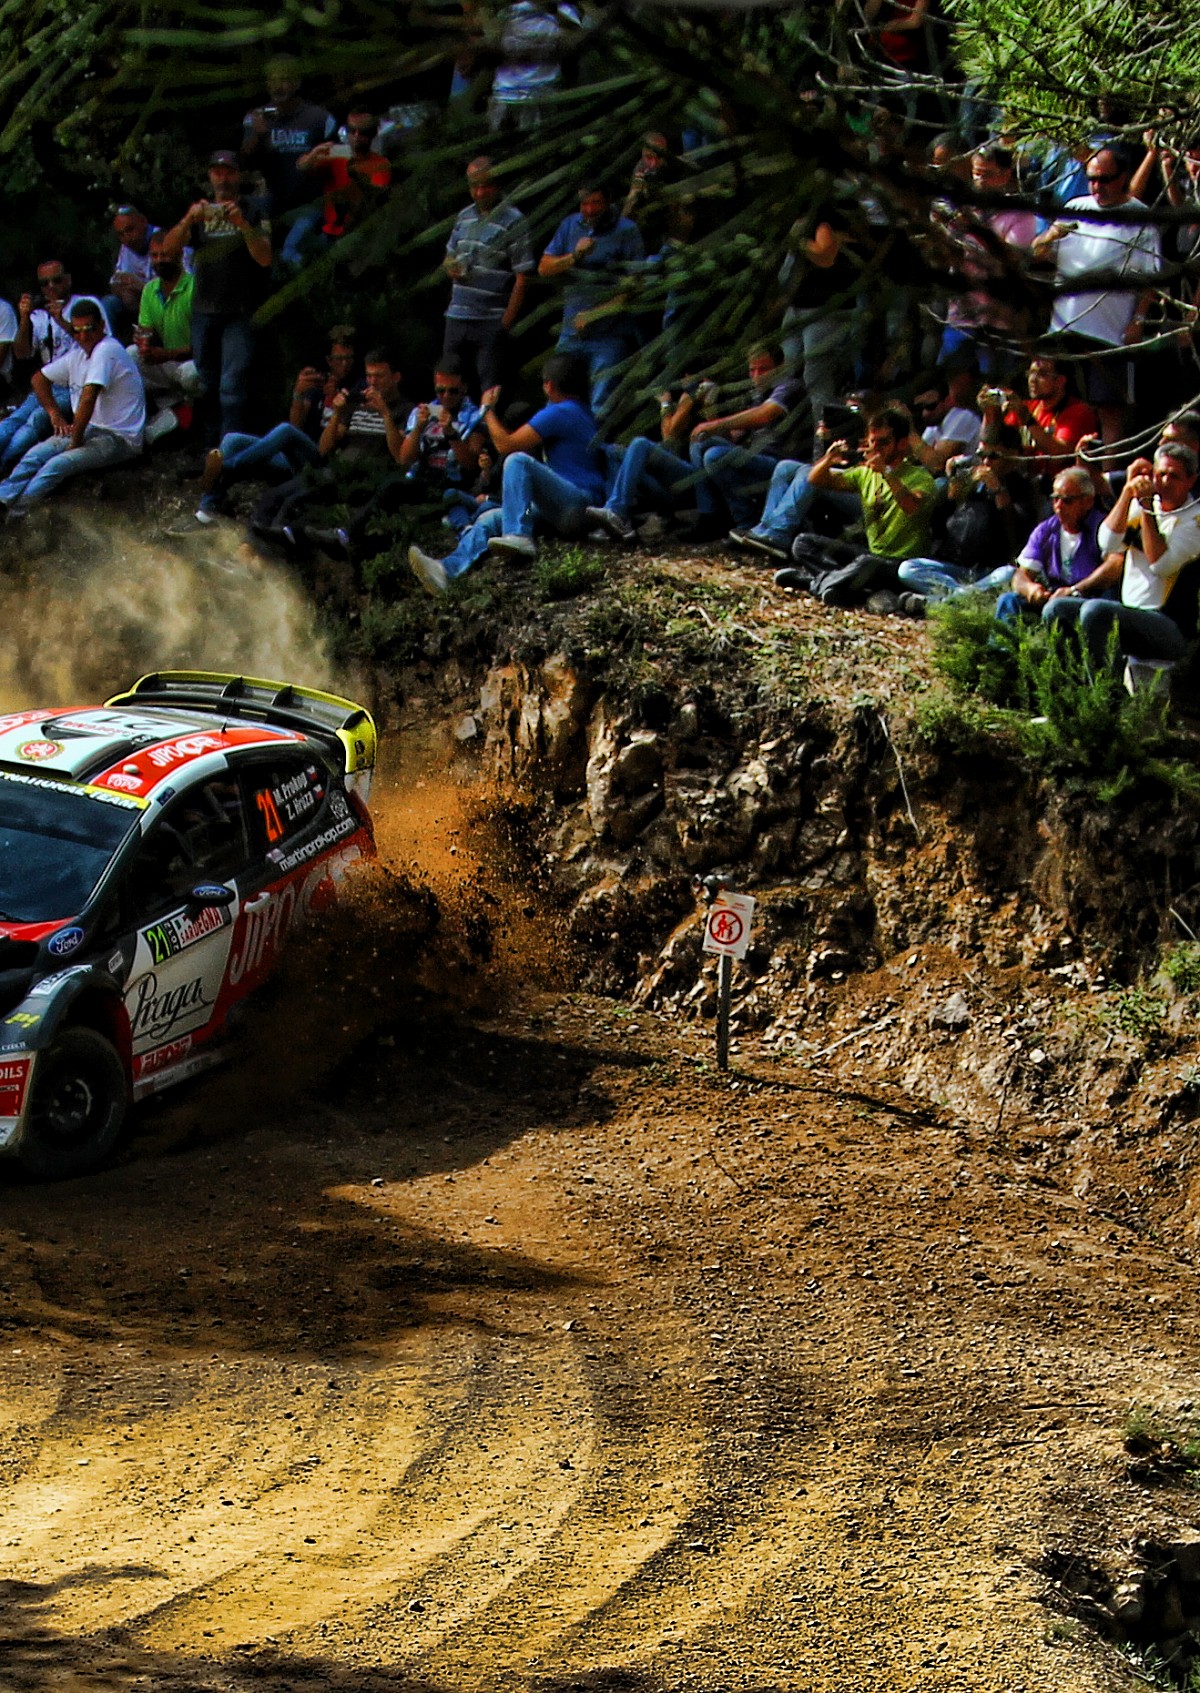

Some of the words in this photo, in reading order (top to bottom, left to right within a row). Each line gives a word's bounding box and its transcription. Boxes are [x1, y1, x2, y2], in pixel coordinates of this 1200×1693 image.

[6, 774, 85, 797] NATIONAL
[89, 789, 141, 809] TEAM
[256, 788, 284, 843] 21
[279, 817, 355, 872] martinprokop.com
[54, 932, 79, 952] Ford
[147, 925, 170, 963] 21
[123, 972, 214, 1041] Praga
